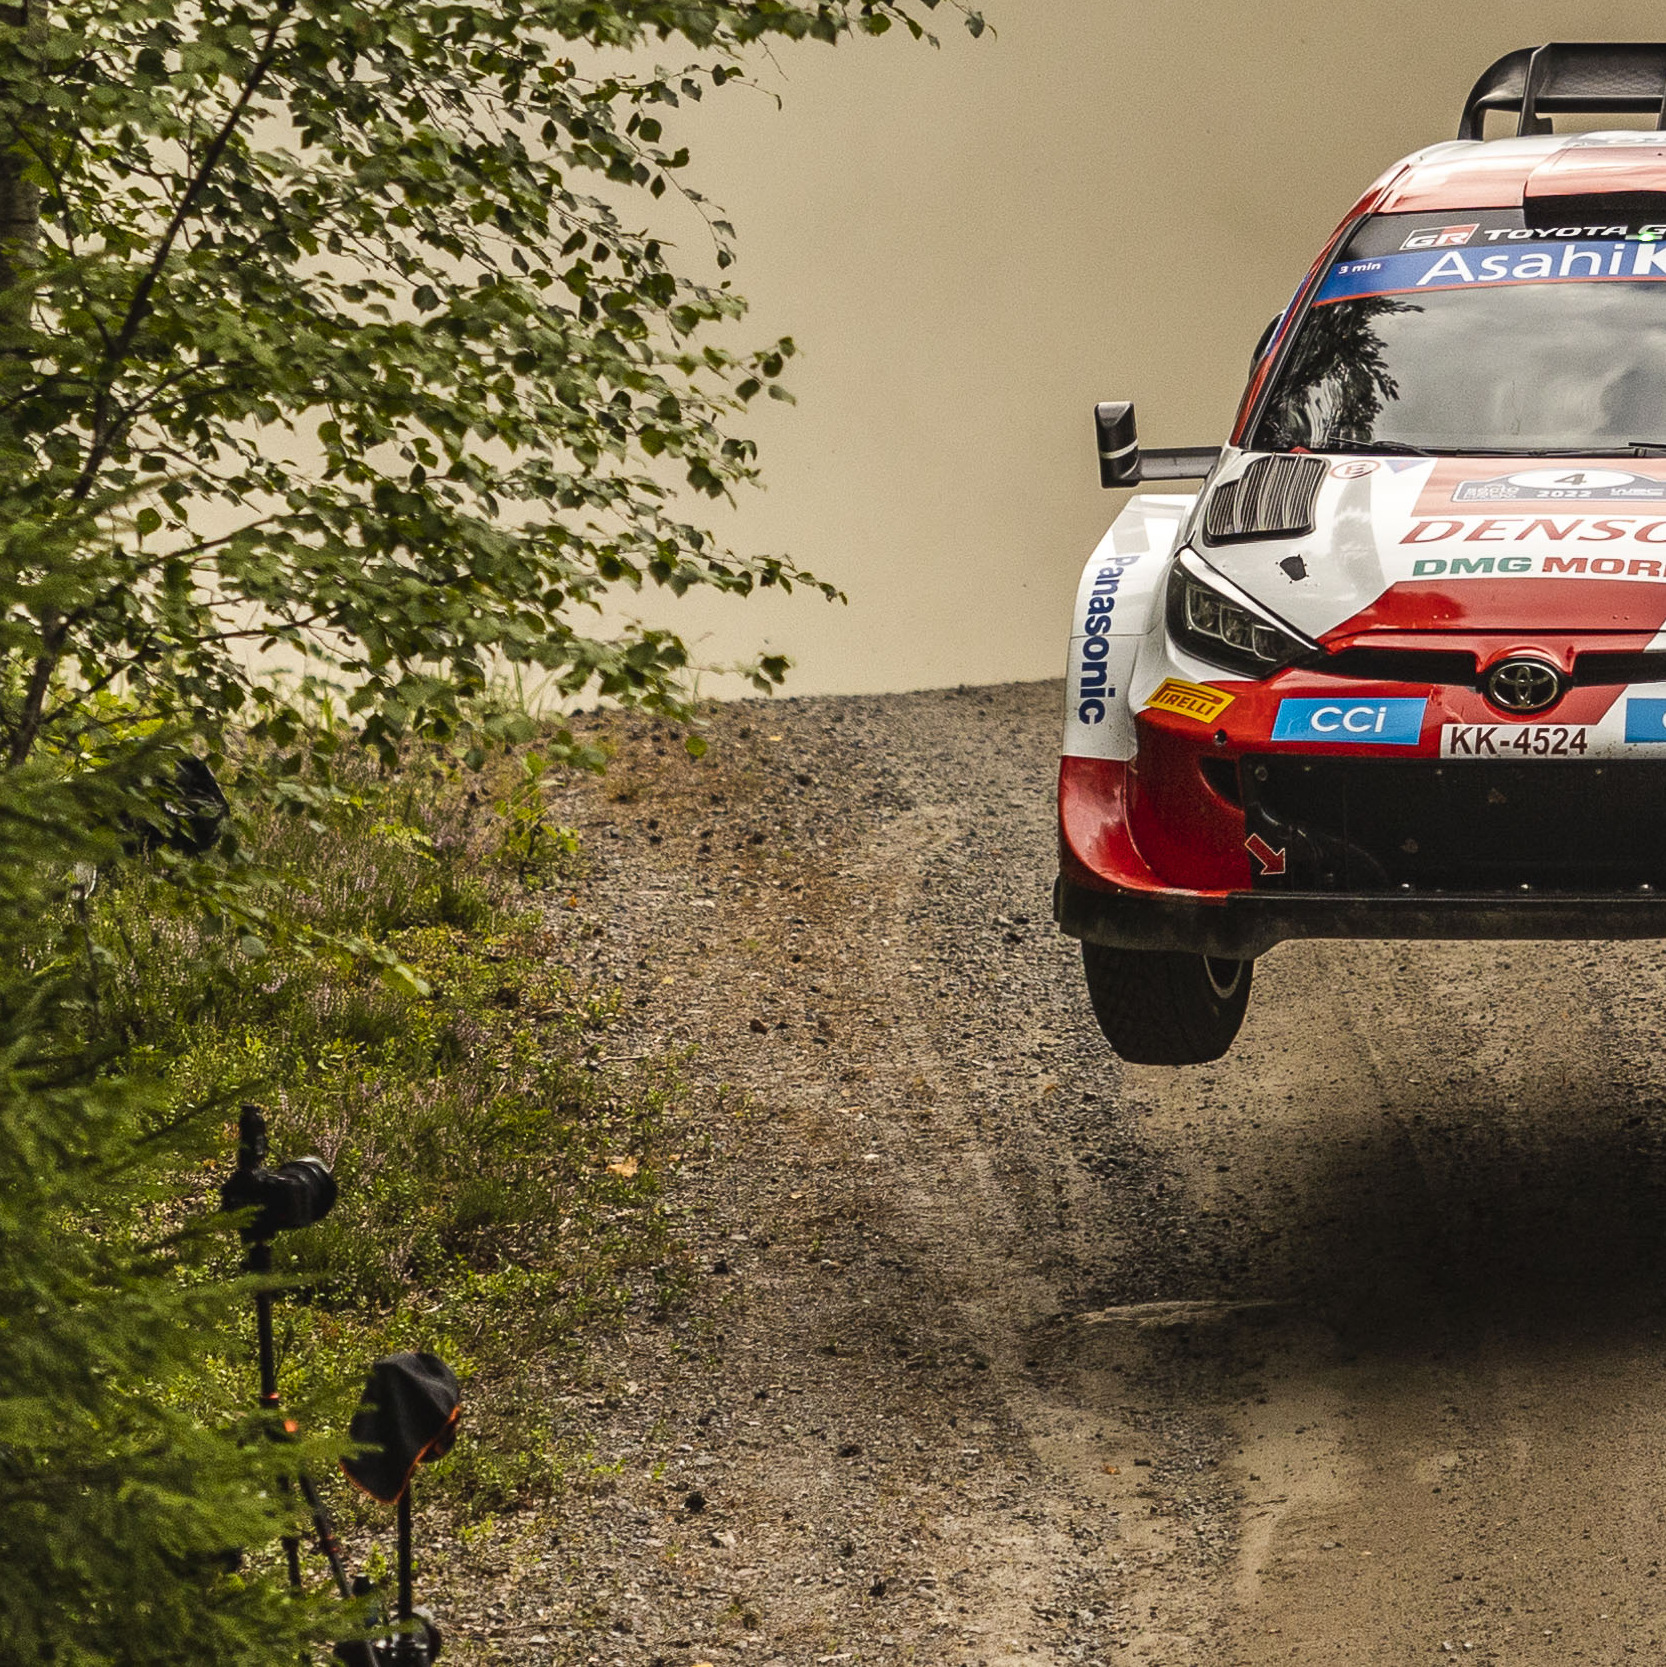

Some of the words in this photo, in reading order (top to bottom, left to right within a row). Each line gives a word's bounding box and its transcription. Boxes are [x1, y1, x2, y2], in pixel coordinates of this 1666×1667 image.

[1405, 231, 1469, 247] GR
[1484, 225, 1629, 241] TOYOTA
[1338, 265, 1348, 275] 3
[1352, 262, 1381, 273] min
[1553, 473, 1587, 486] 4
[1536, 490, 1592, 498] 2022
[1412, 556, 1533, 577] DMG
[1078, 554, 1141, 725] Panasonic
[1151, 682, 1225, 717] PIRELLI
[1449, 726, 1588, 755] KK-4524
